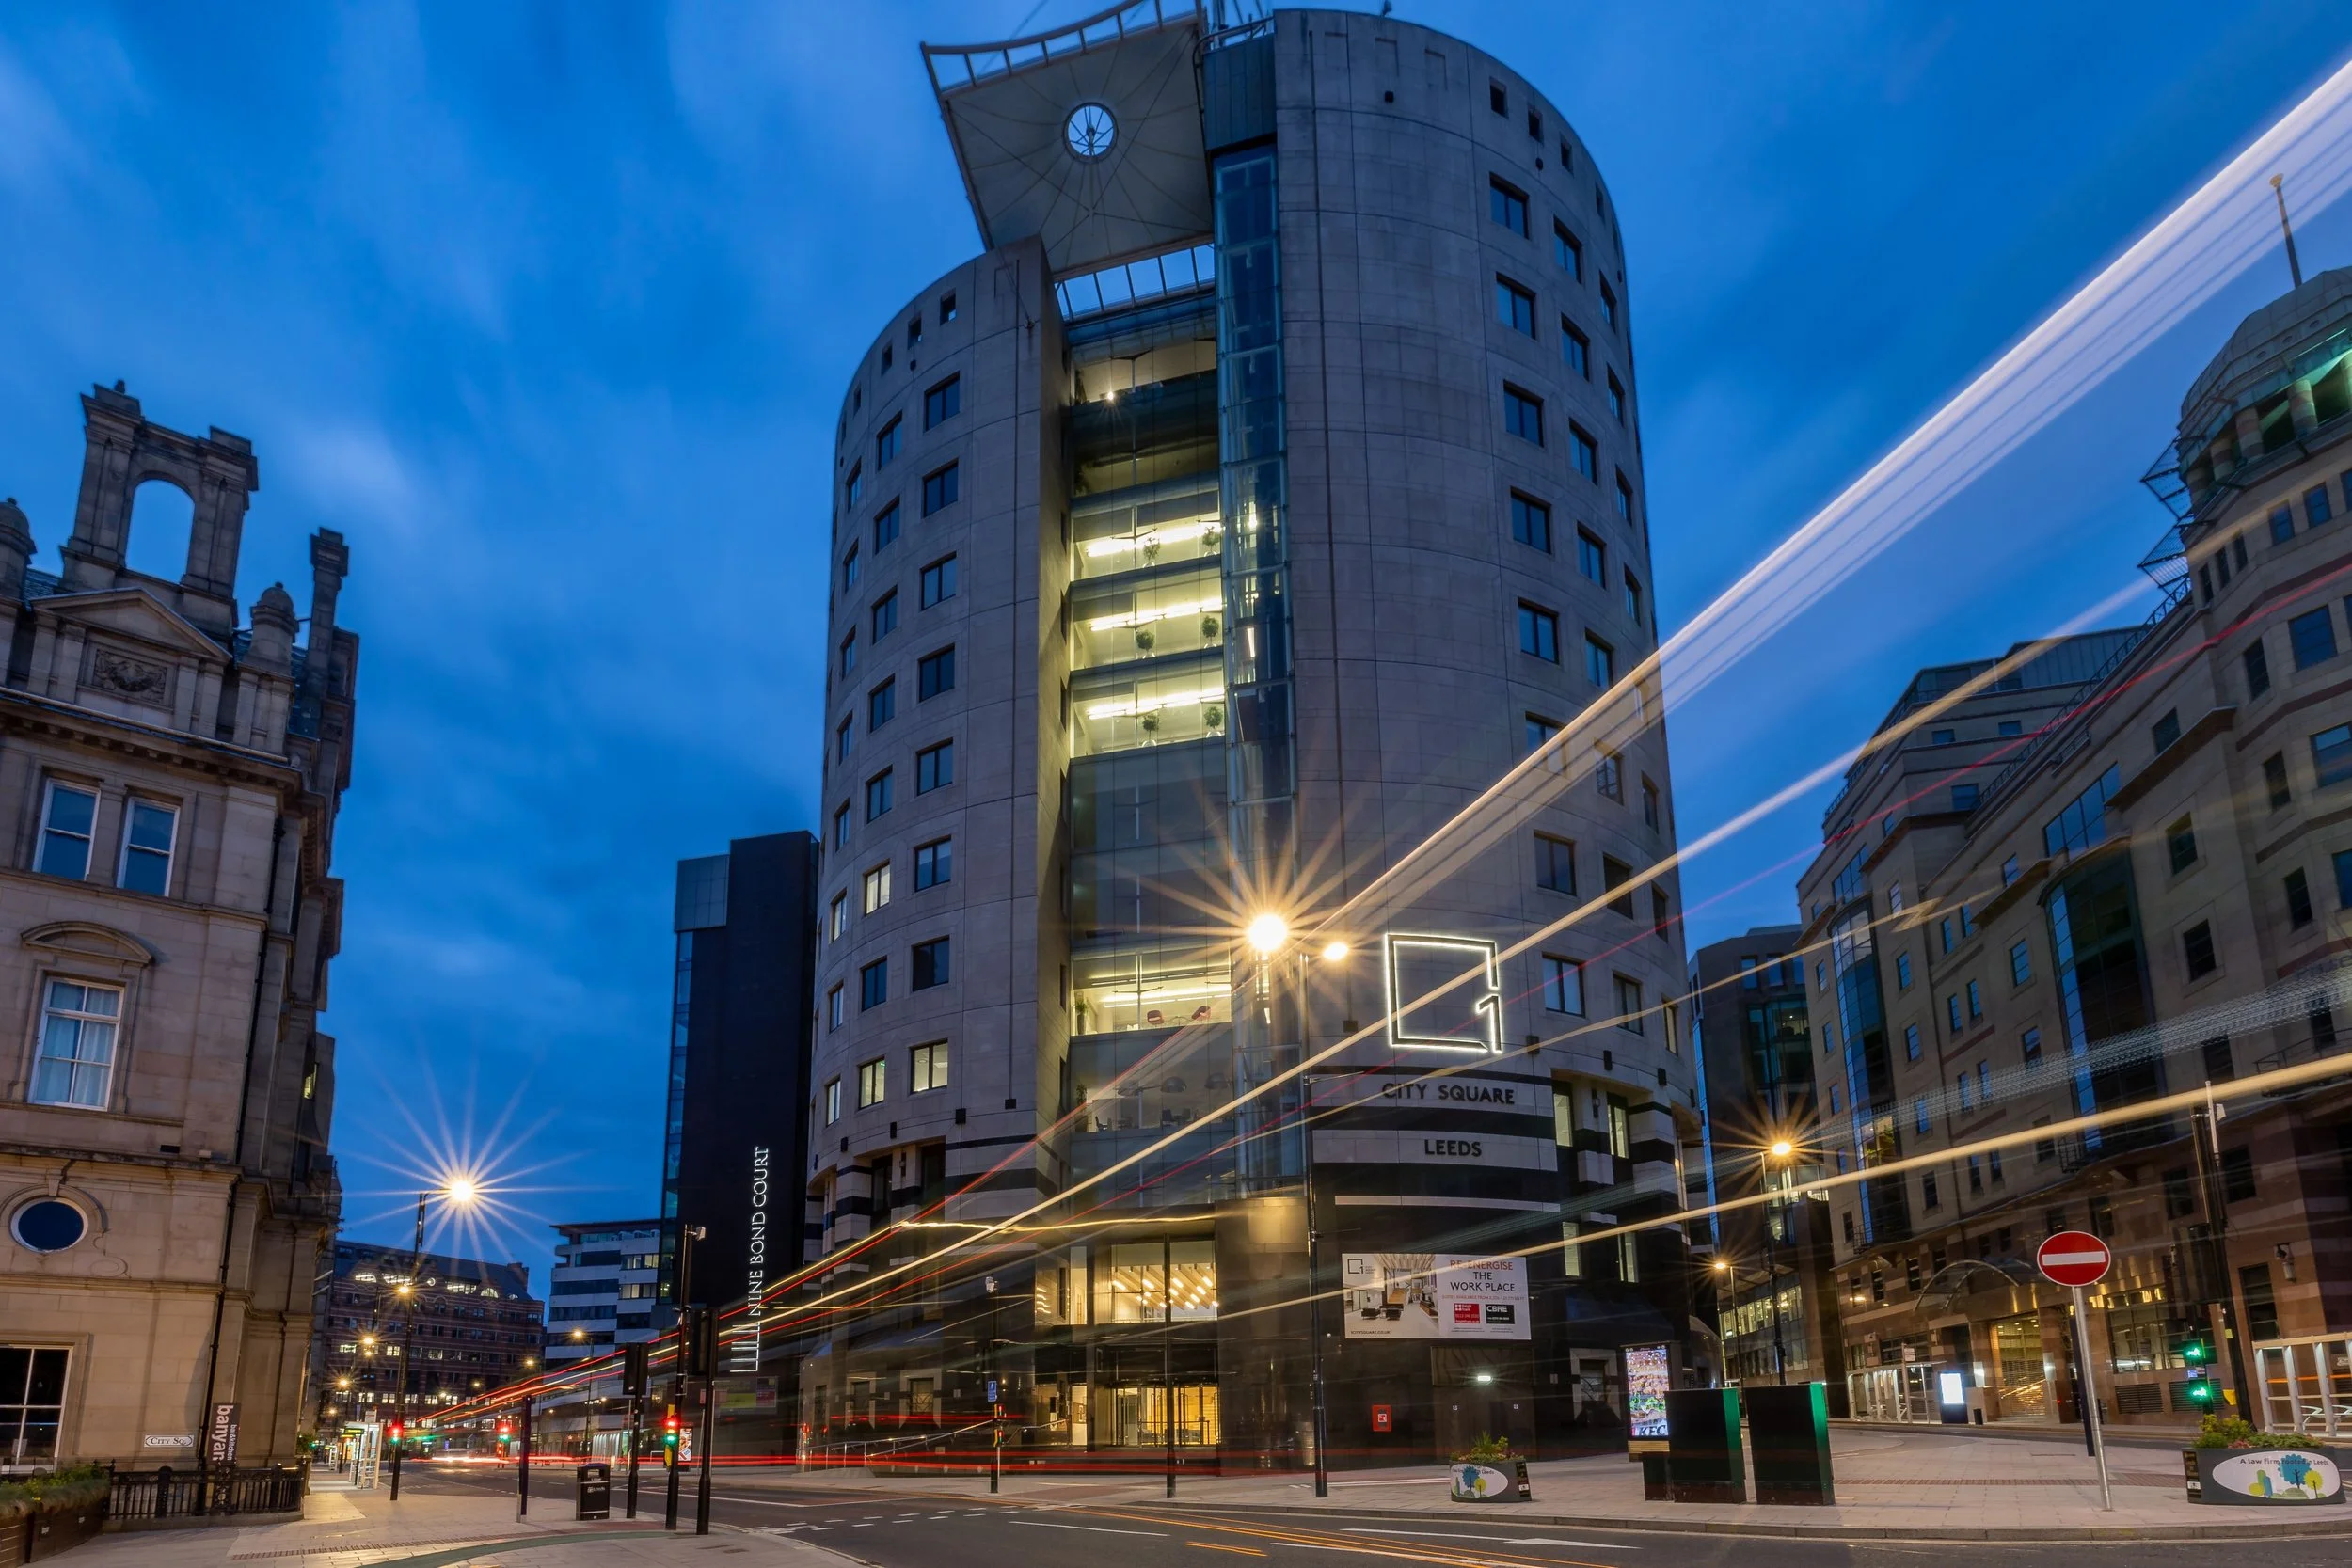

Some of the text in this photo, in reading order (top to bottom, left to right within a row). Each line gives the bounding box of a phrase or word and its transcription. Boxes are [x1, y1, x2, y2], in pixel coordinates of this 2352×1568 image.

[1382, 1083, 1515, 1104] CITY SQUARE
[1424, 1139, 1482, 1157] LEEDS
[748, 1146, 769, 1316] NINE BOND COURT
[1473, 1272, 1492, 1280] THE
[1450, 1282, 1516, 1291] WORK PLACE
[212, 1405, 233, 1461] banyan
[1639, 1425, 1666, 1436] KFC
